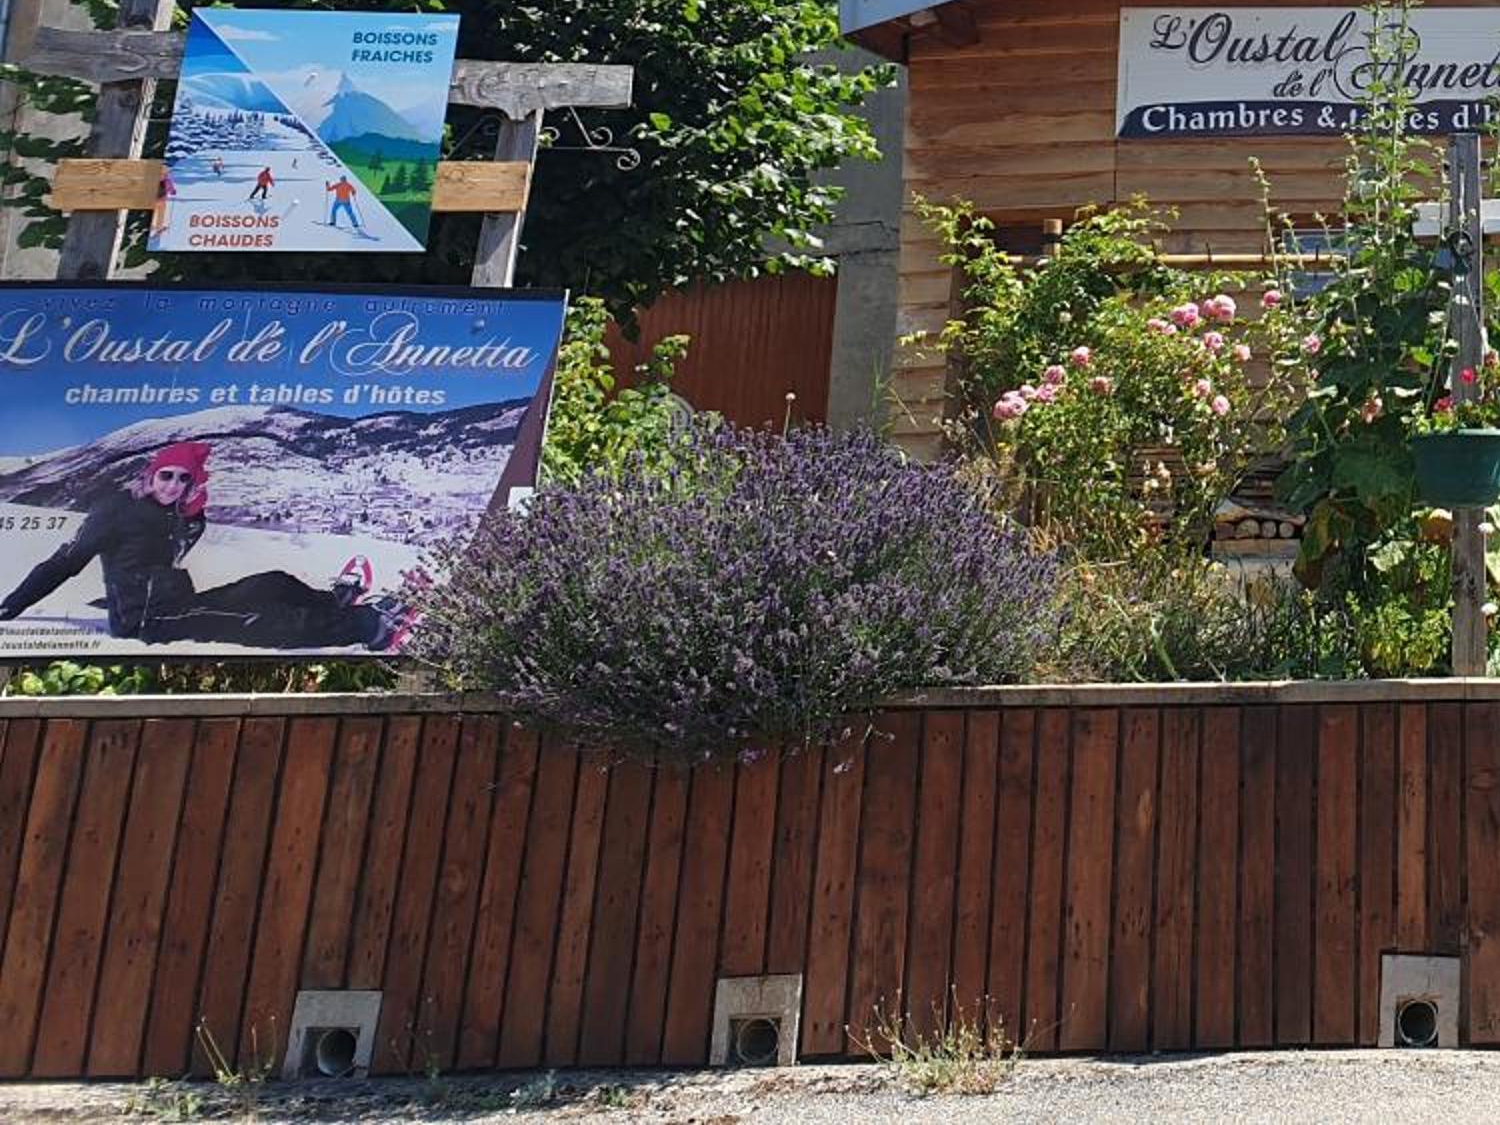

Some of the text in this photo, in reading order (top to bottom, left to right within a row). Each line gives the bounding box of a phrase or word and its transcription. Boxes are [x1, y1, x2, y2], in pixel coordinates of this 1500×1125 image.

[353, 31, 438, 46] BOISSONS
[1150, 11, 1357, 64] L'Oustal
[351, 48, 433, 63] FRAICHES
[1142, 102, 1303, 132] Chambres
[1316, 105, 1336, 128] &
[189, 214, 280, 228] BOISSONS
[189, 234, 273, 247] CHAUDES
[0, 308, 233, 365] L'Oustal
[64, 383, 447, 406] chambres et tables d'hôtes
[20, 516, 41, 530] 25
[46, 516, 68, 530] 37
